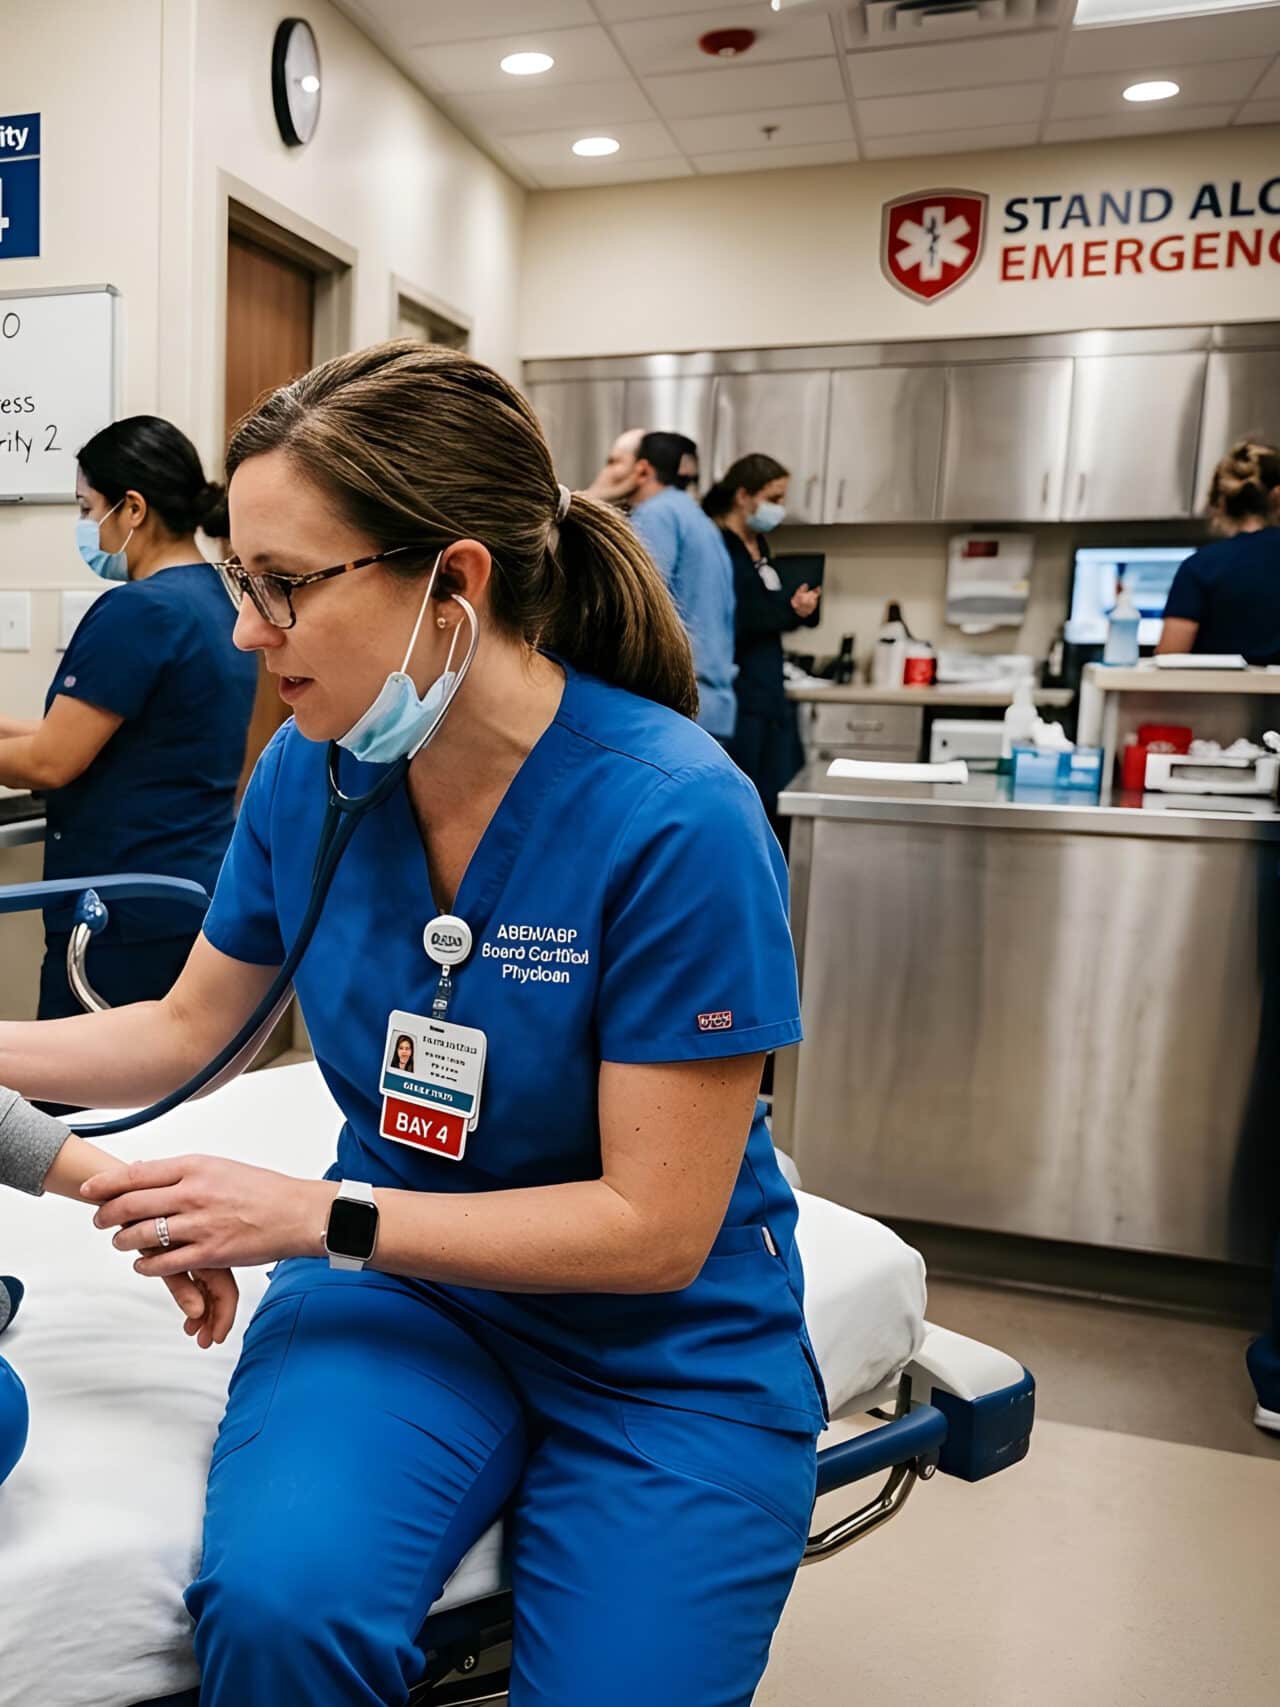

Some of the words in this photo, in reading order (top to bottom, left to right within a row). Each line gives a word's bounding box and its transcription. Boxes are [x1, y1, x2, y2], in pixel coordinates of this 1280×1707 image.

[1002, 187, 1174, 235] STAND
[43, 424, 63, 452] 2
[395, 1111, 433, 1139] BAY
[435, 1125, 449, 1145] 4
